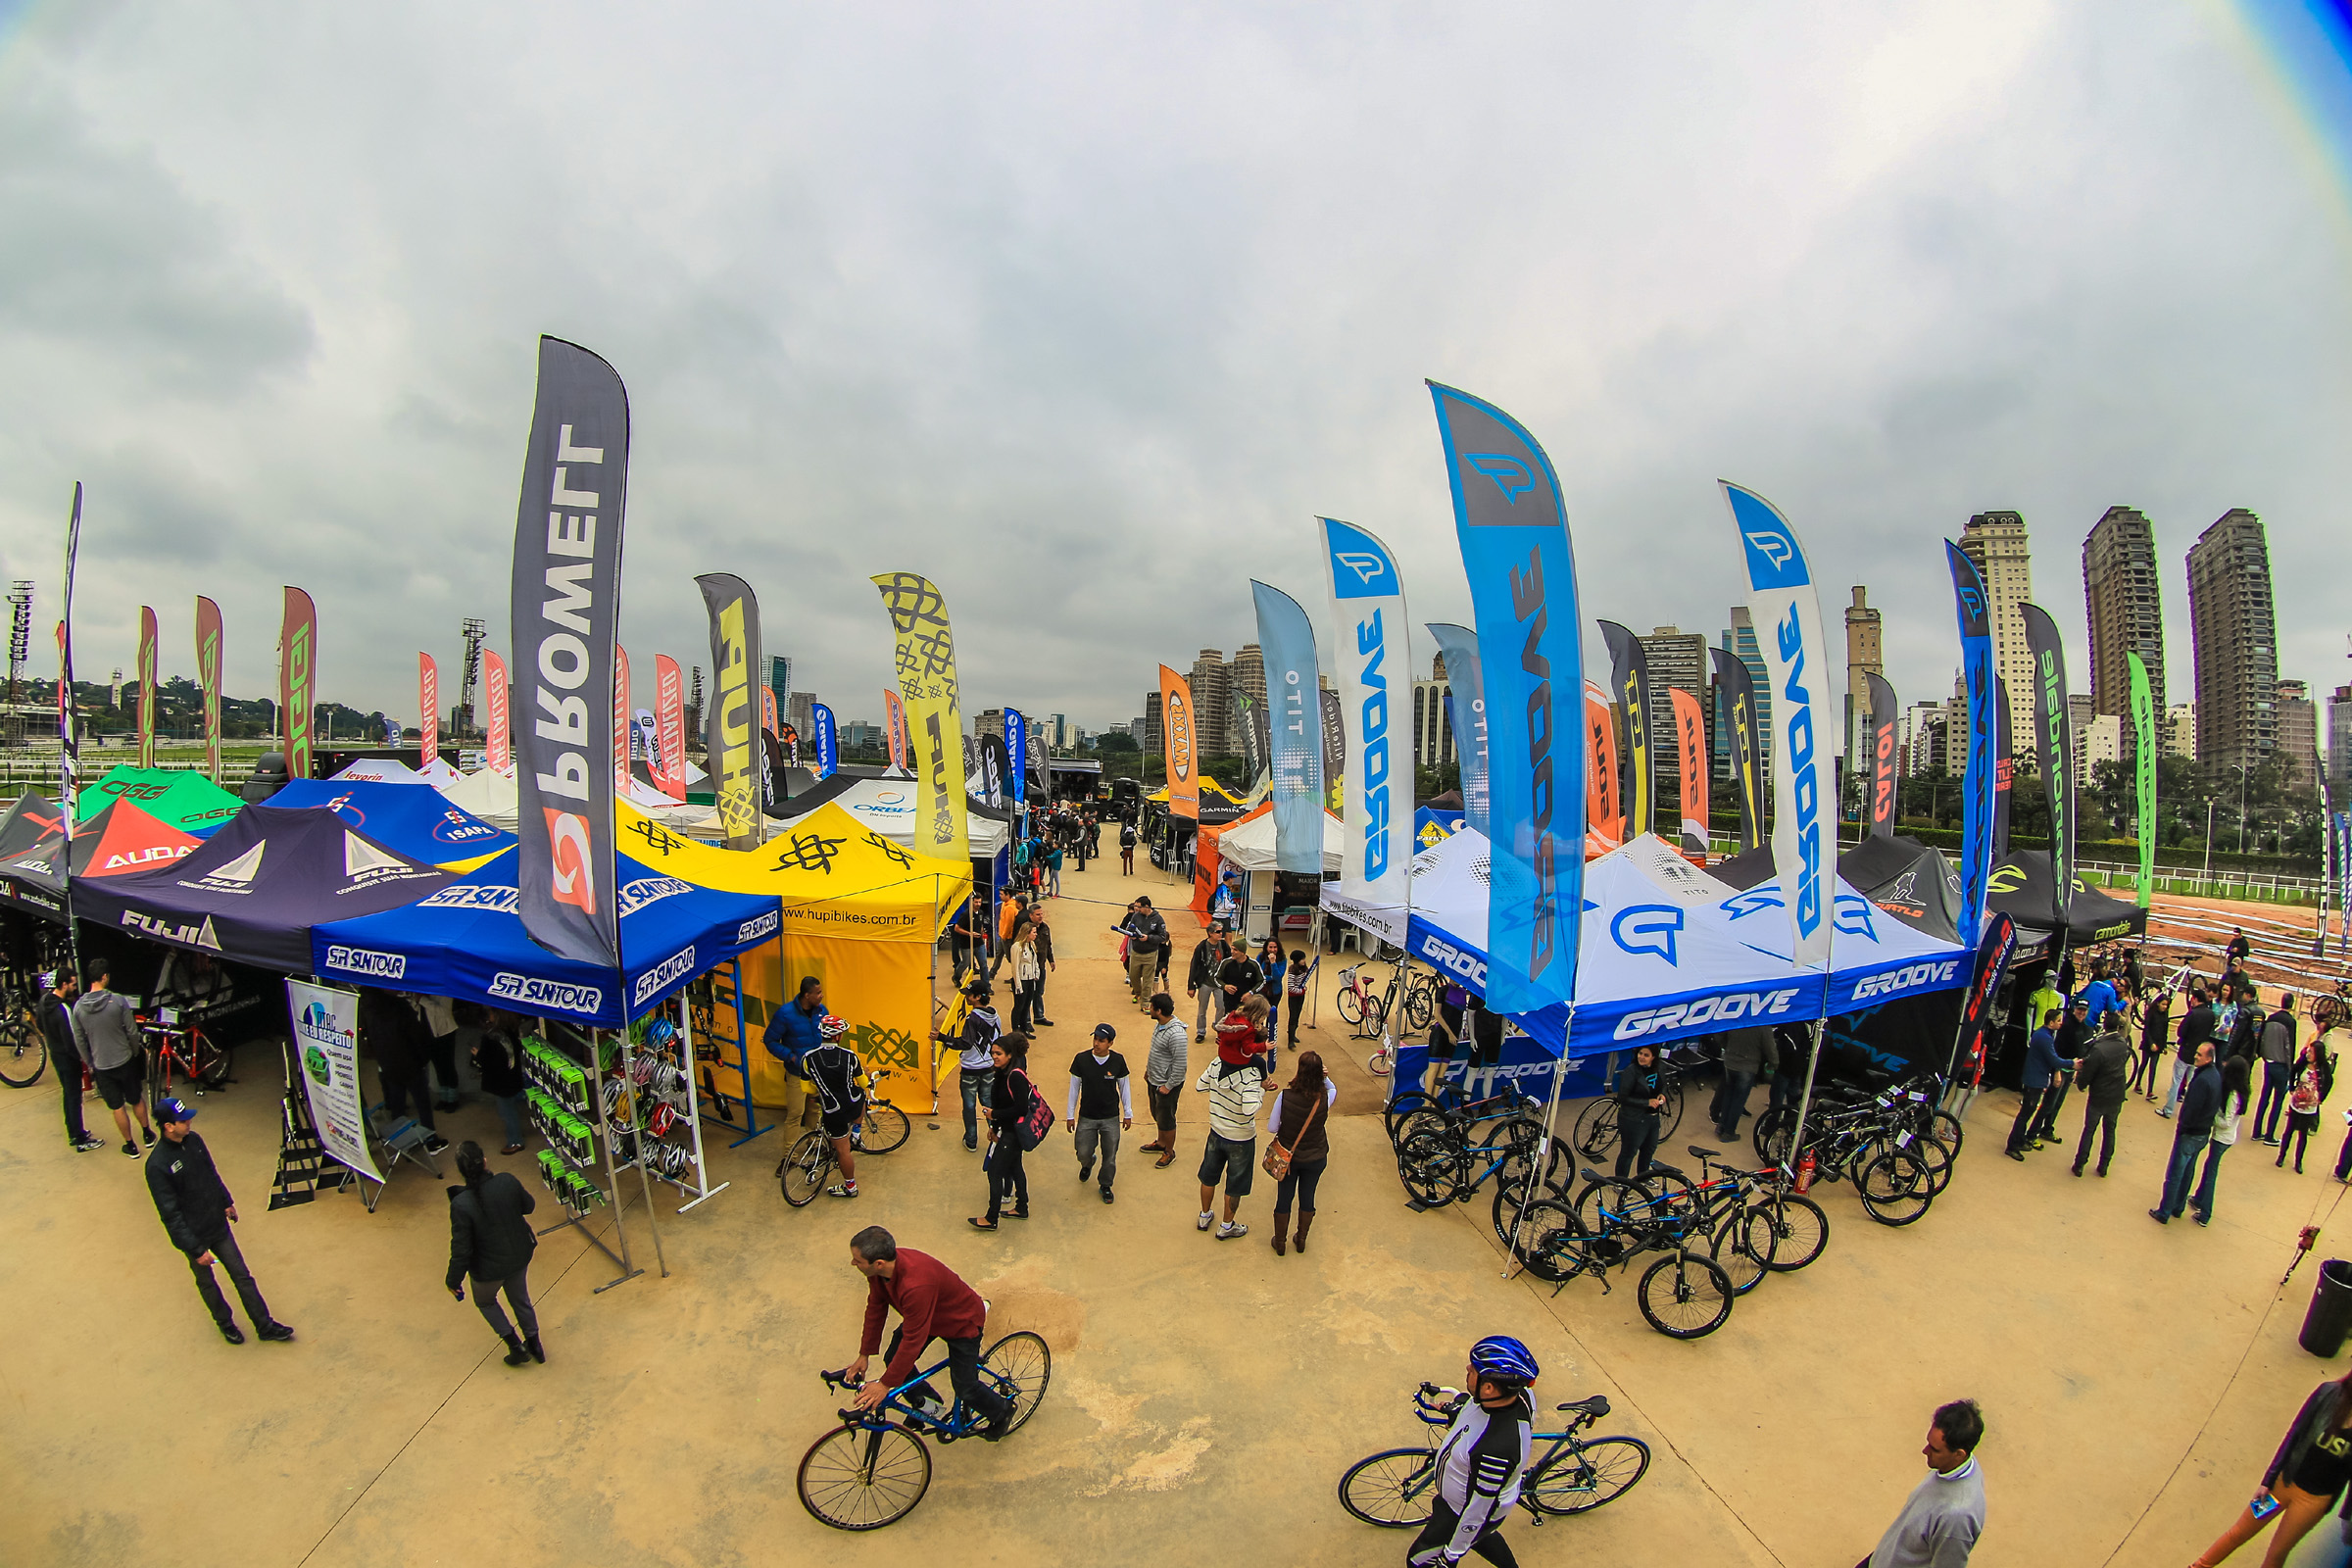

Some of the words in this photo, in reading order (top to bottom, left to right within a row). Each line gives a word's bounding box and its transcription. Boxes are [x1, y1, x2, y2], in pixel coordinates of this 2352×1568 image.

[344, 770, 383, 781] levorin
[447, 826, 494, 840] ISAPA
[105, 845, 199, 869] AUDA
[198, 877, 248, 888] FUJI
[354, 867, 414, 882] FUJI
[336, 880, 378, 896] CONQUISTE
[379, 876, 400, 885] SUAS
[121, 910, 199, 944] FUJI
[2094, 920, 2131, 940] cannondale
[326, 945, 350, 969] SR
[350, 948, 406, 978] SUNTOUR
[634, 969, 658, 1007] SR
[656, 946, 694, 992] SUNTOUR
[1852, 960, 1959, 1001] GROOVE
[488, 972, 524, 997] SR
[524, 978, 602, 1014] SUNTOUR
[1613, 989, 1799, 1040] GROOVE
[318, 1027, 353, 1049] RESPEITO
[326, 1049, 342, 1059] Quem
